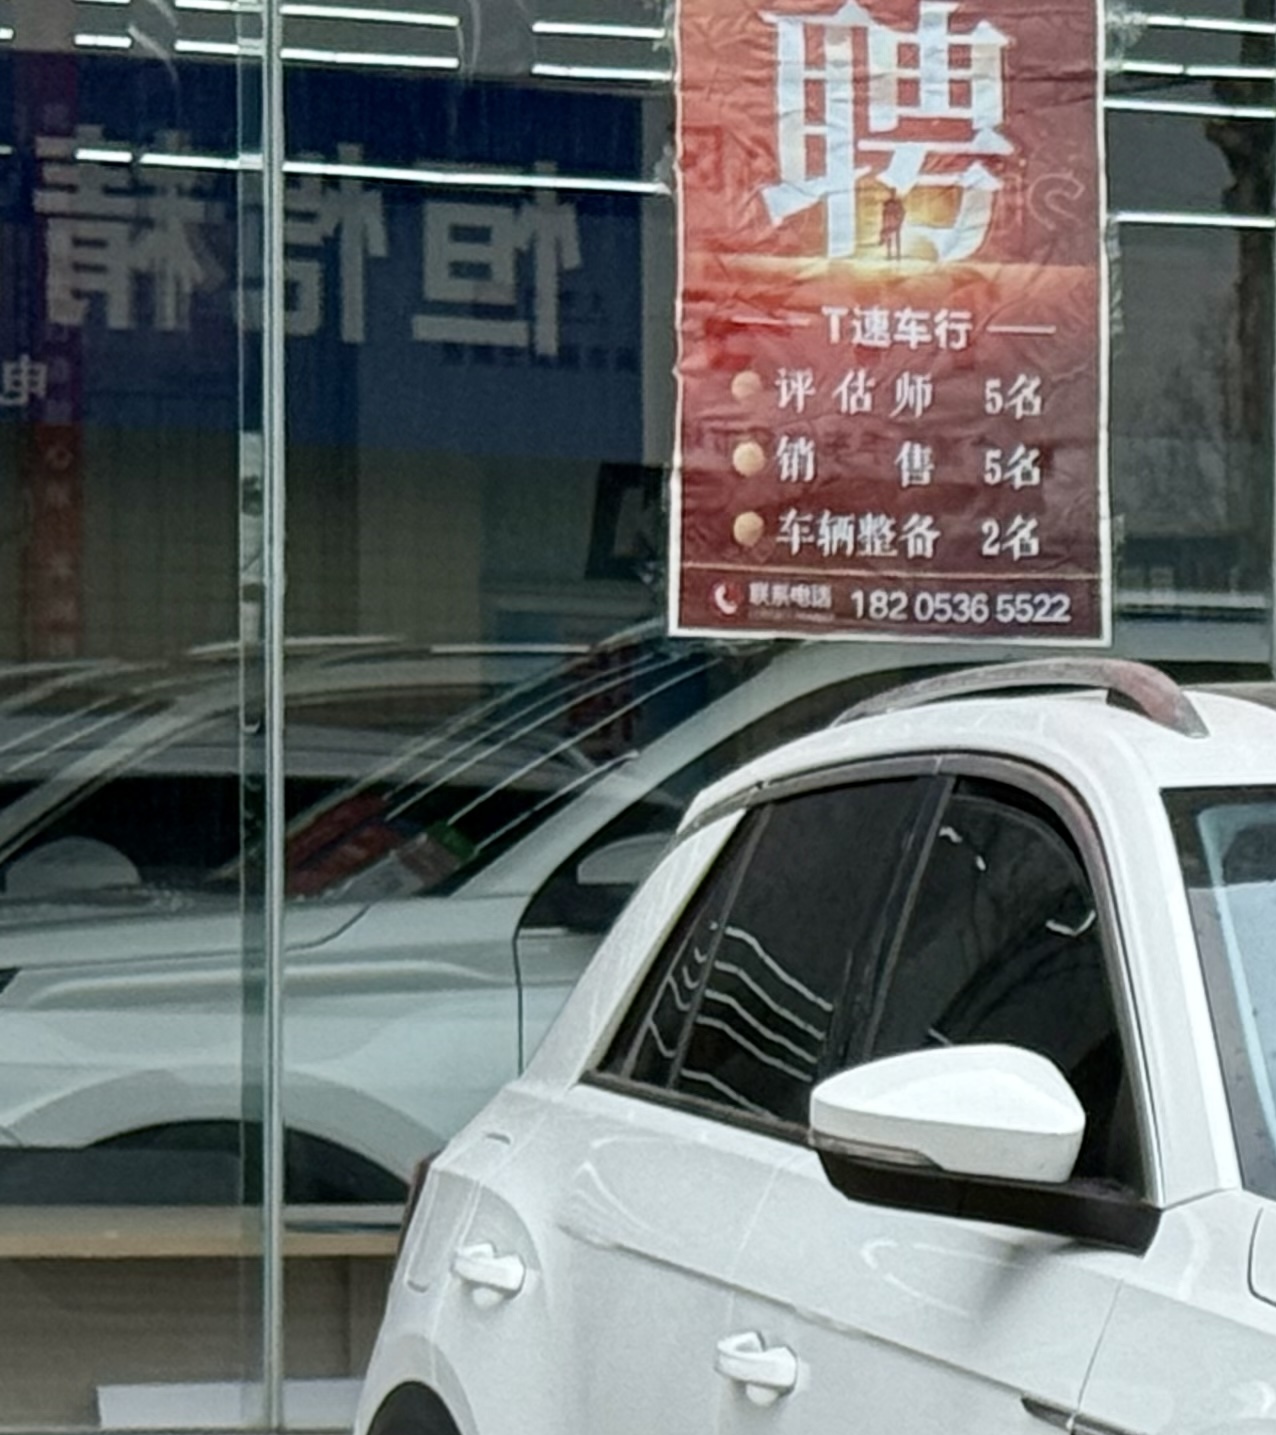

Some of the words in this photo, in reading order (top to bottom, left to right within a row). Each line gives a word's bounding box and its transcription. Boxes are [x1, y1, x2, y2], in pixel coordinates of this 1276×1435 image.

[758, 0, 1014, 261] 聘
[822, 305, 974, 350] T速车行
[775, 369, 934, 418] 评估师
[984, 374, 1043, 420] 5名
[775, 437, 936, 488] 销售
[983, 444, 1042, 490] 5名
[776, 509, 940, 559] 车辆整备
[981, 516, 1041, 561] 2名
